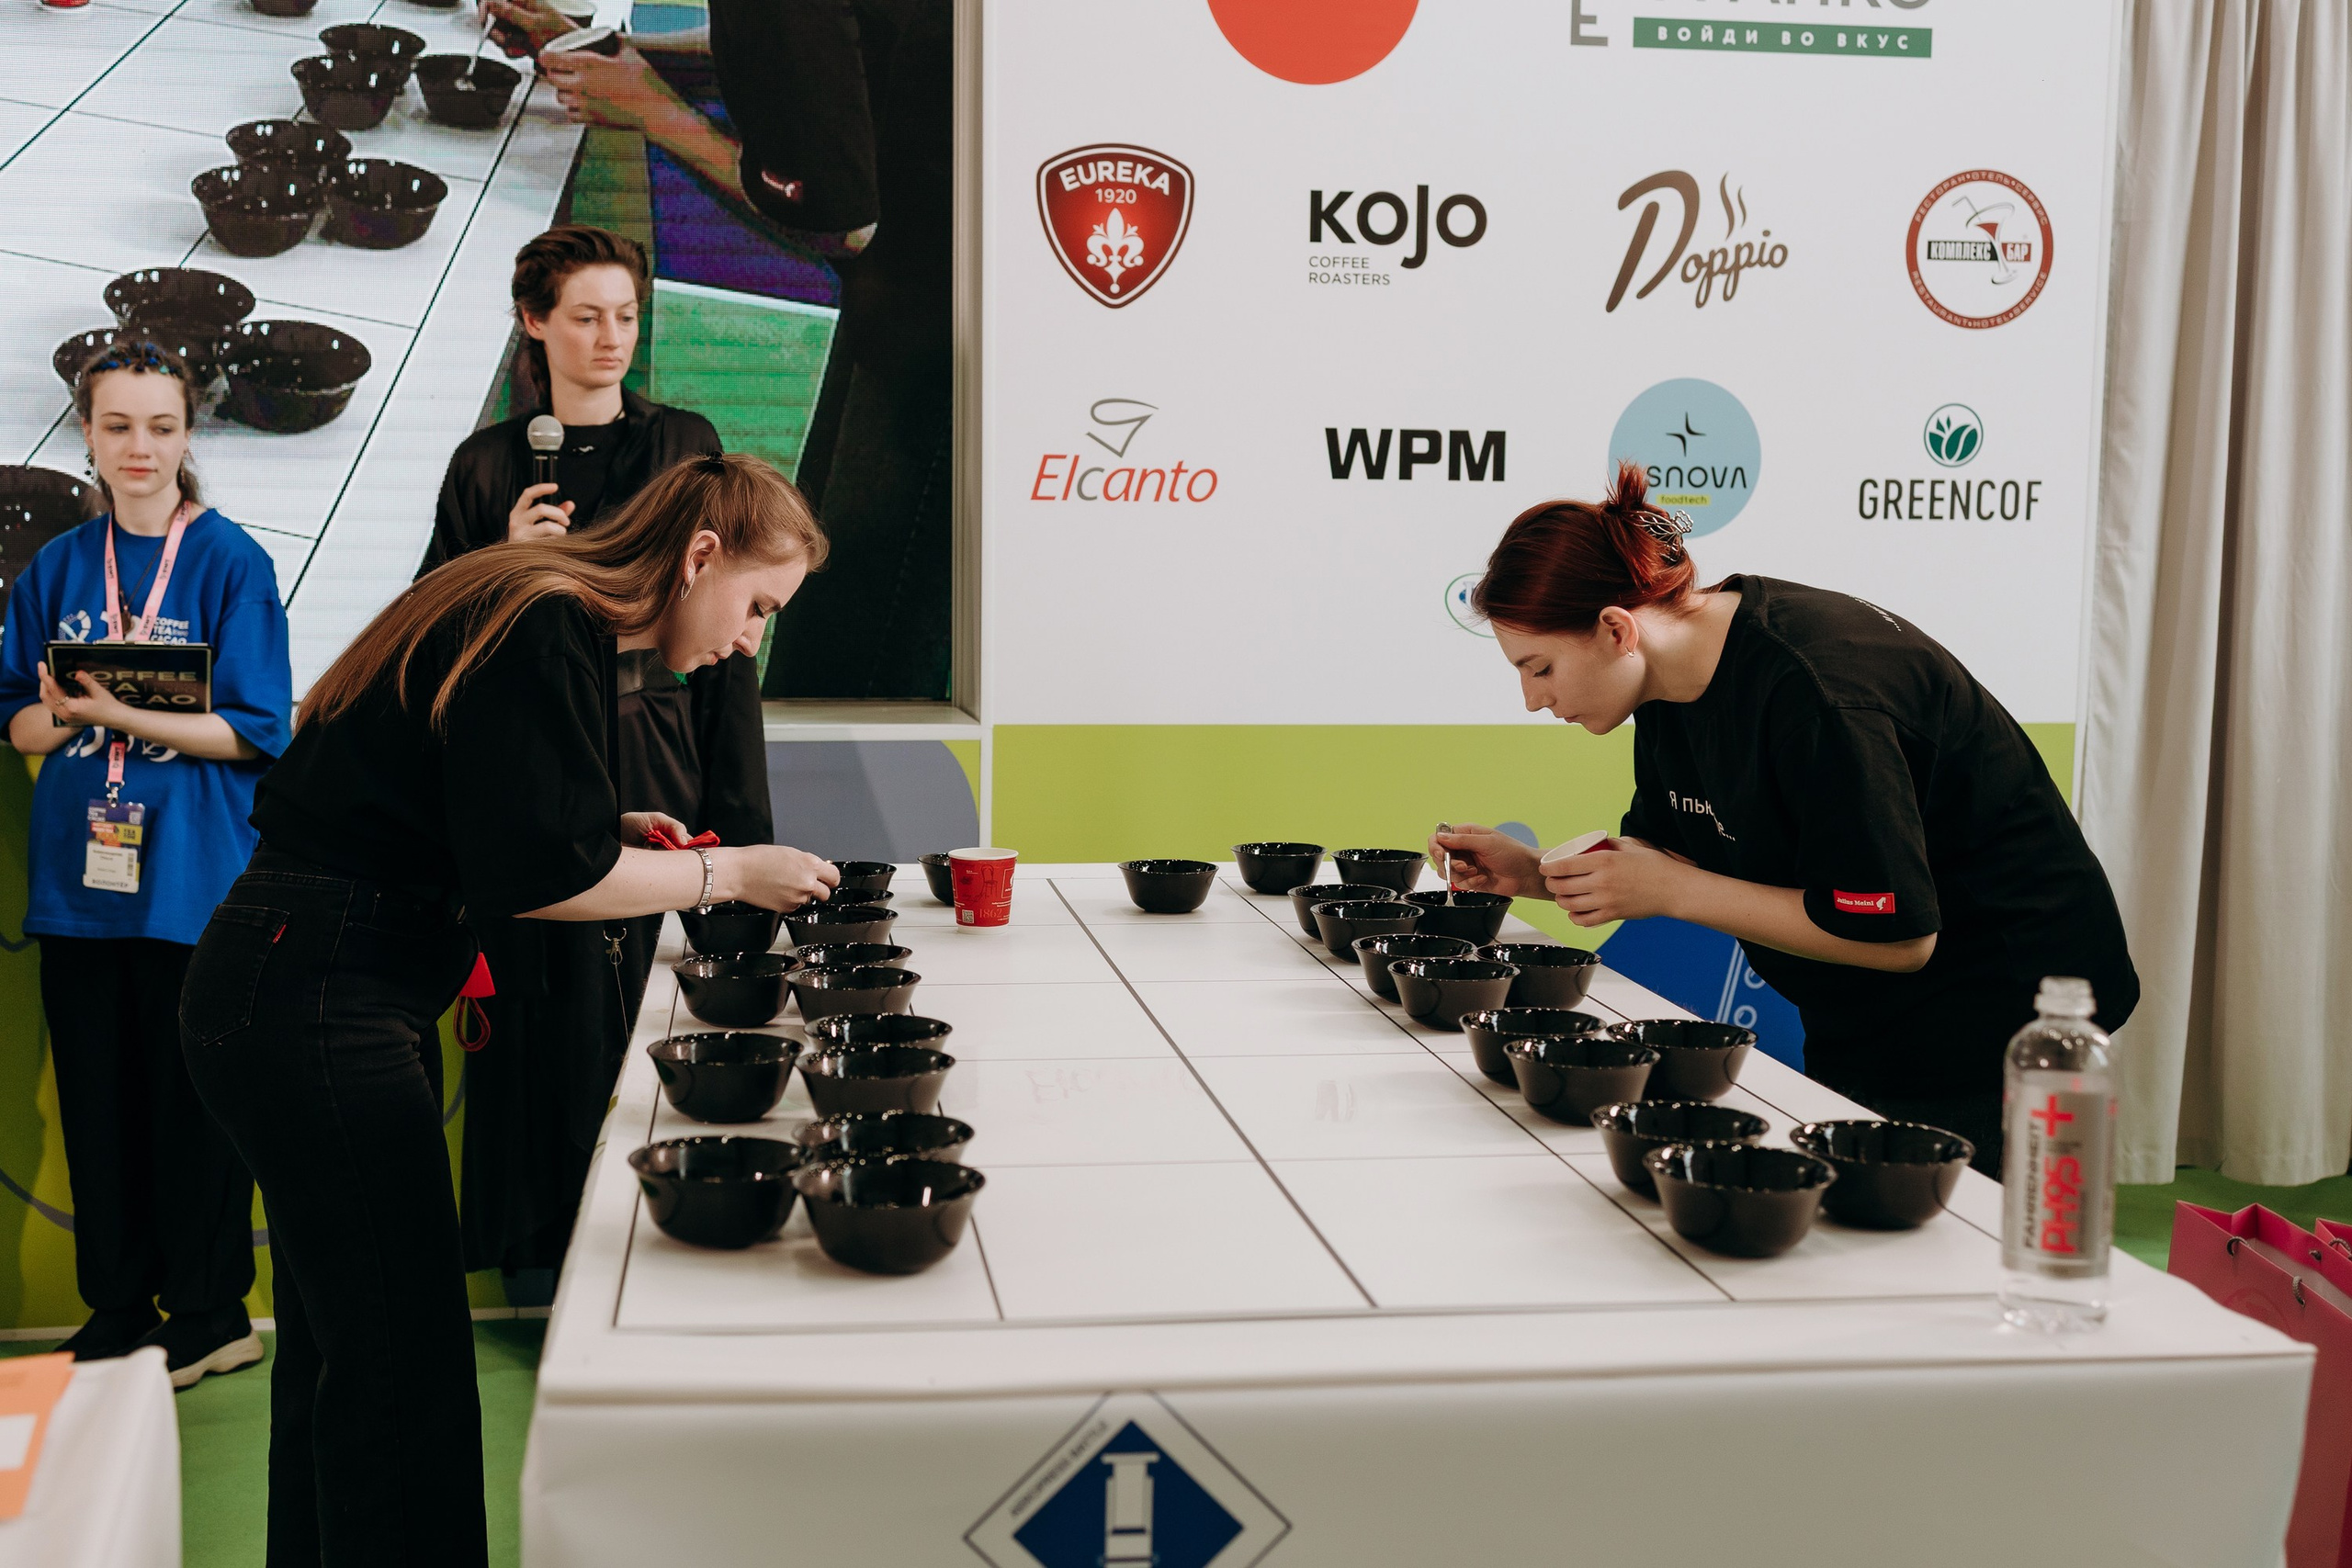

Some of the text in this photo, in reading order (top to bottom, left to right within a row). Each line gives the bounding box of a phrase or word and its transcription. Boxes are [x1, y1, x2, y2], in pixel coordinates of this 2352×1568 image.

[1657, 25, 1909, 50] ВОЙДИ ВО ВКУС
[1058, 160, 1170, 196] EUREKA
[1971, 171, 2010, 186] ОТЕЛЬ
[1095, 188, 1137, 204] 1920
[1606, 170, 1788, 313] Doppio
[1929, 242, 2029, 262] КОМПЛЕКС БАР
[1308, 256, 1370, 269] COFFEE
[1308, 272, 1391, 286] ROASTERS
[1325, 427, 1506, 481] WPM
[1030, 454, 1218, 502] Elcanto
[1646, 466, 1747, 489] SNOVA
[1660, 494, 1708, 504] foodtech
[1858, 478, 2042, 521] GREENCOF
[153, 626, 173, 636] TEA
[1669, 791, 1678, 809] Я
[1837, 897, 1854, 906] Julius
[978, 908, 1003, 919] 1862
